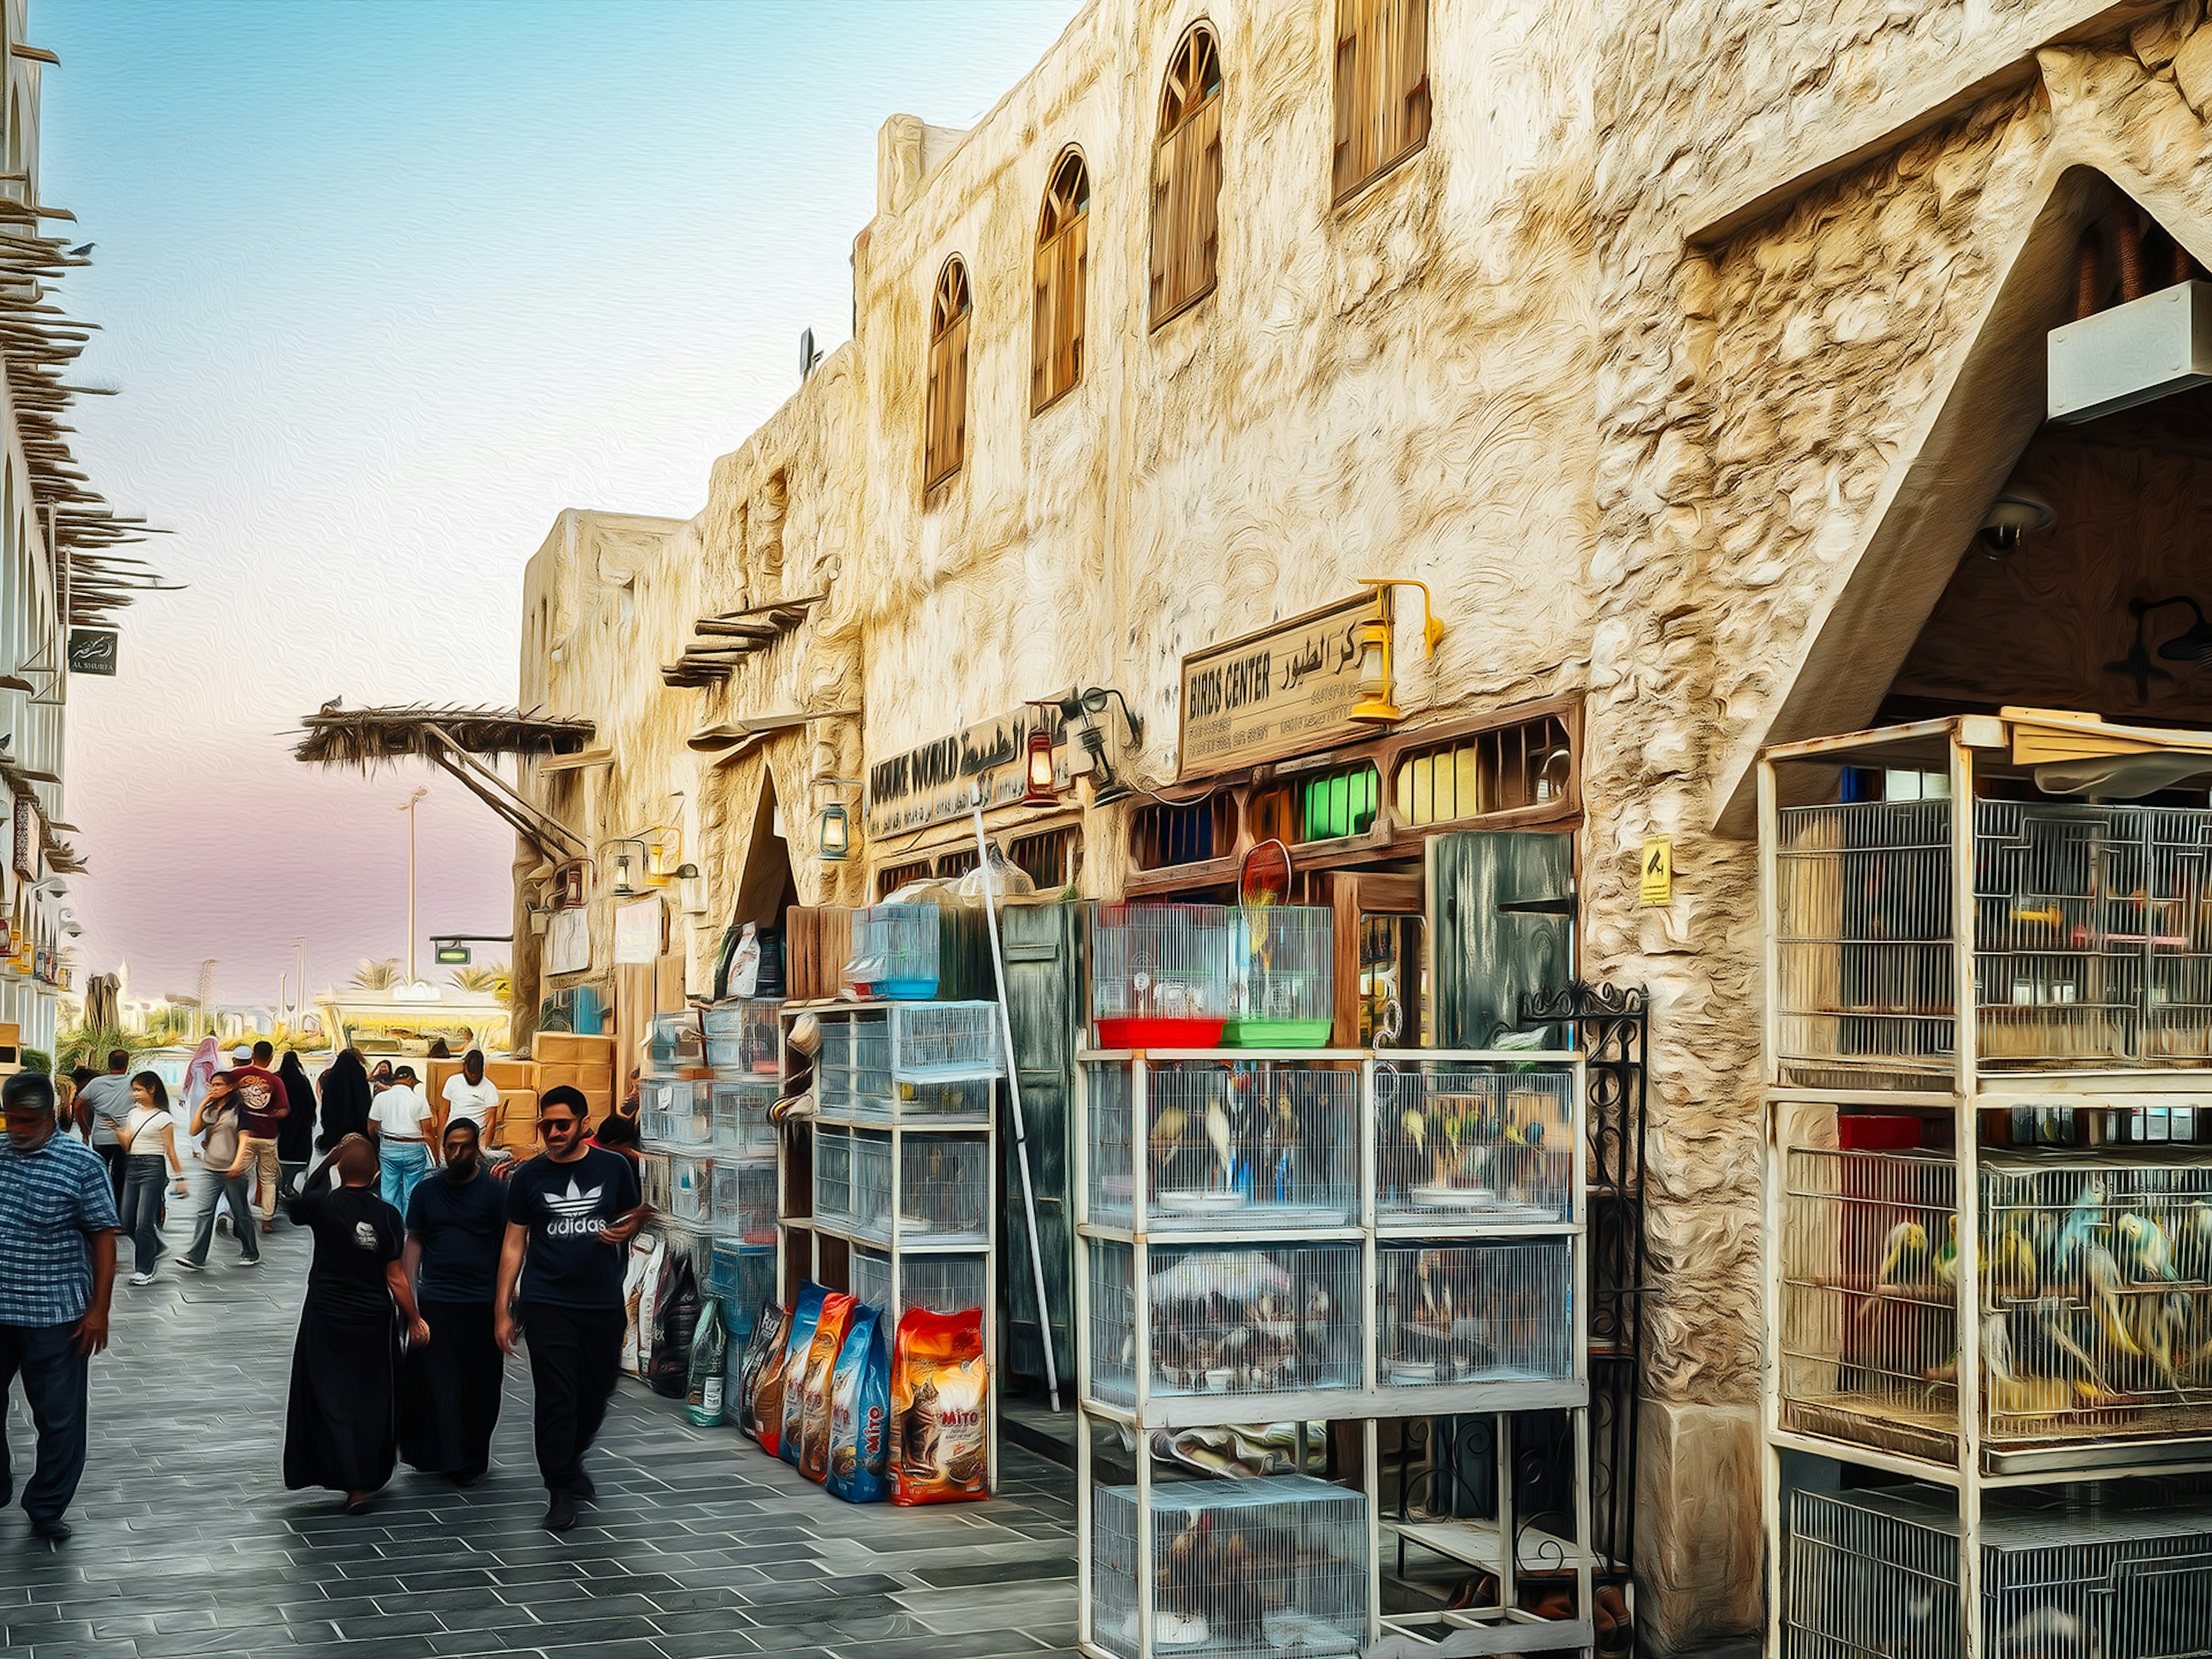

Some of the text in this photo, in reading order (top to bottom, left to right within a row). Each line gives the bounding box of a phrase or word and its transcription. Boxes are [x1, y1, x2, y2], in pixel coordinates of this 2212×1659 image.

[1190, 667, 1221, 719] BIRDS
[1225, 652, 1270, 710] CENTER
[1280, 619, 1365, 690] ركز الطيور
[871, 755, 909, 806] NATURE
[912, 737, 958, 793] WORLD
[547, 1217, 607, 1236] adidas
